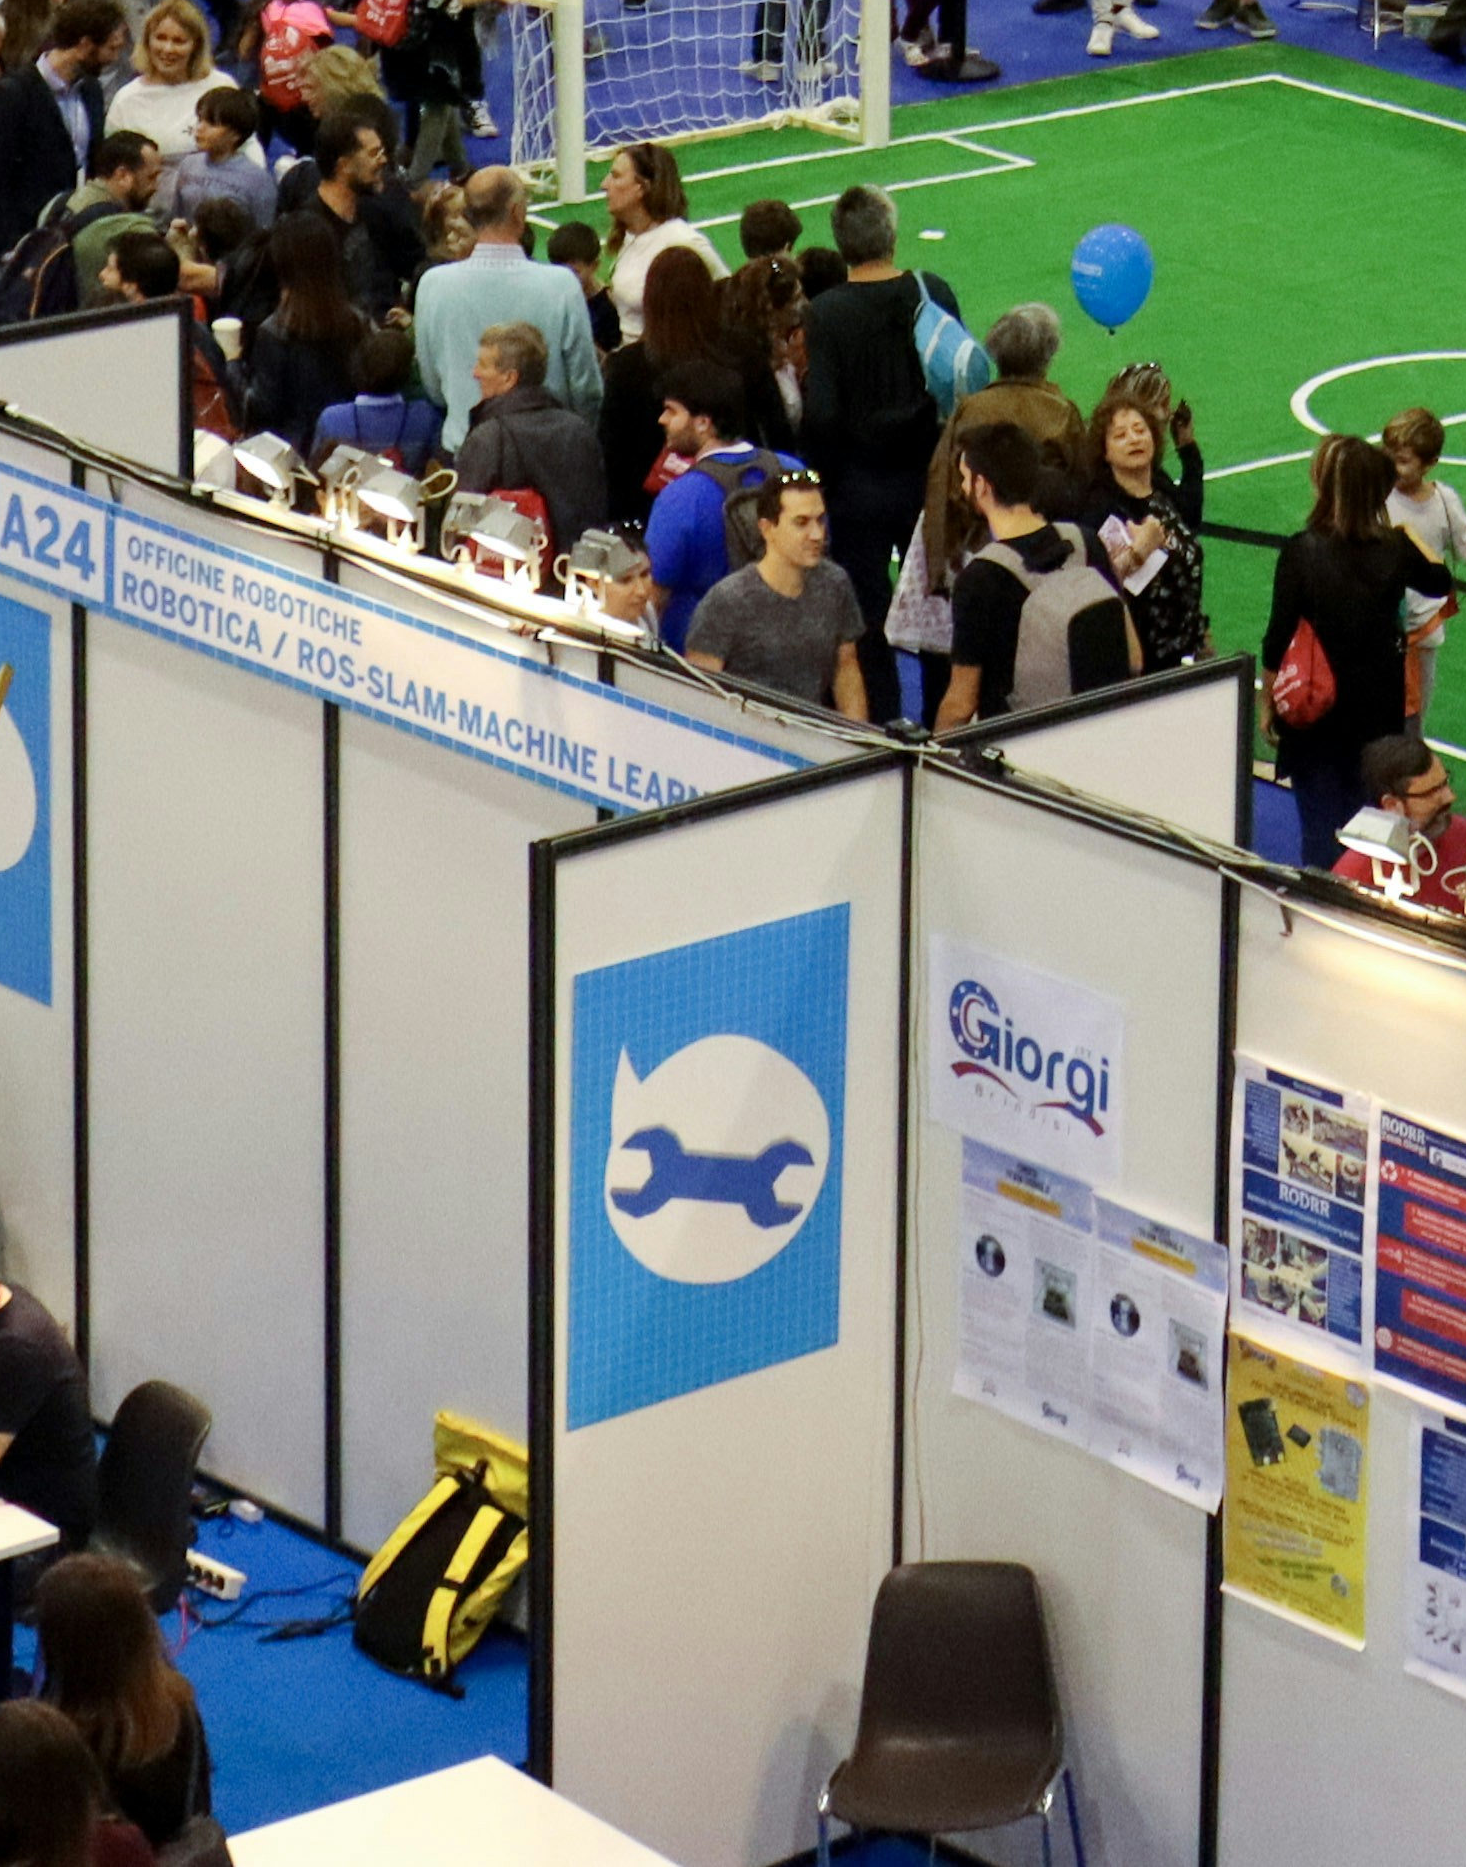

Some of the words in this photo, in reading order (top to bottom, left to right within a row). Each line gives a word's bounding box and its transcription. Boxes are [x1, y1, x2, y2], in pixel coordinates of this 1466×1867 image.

[0, 492, 96, 582] A24
[127, 534, 226, 596] OFFICINE
[232, 573, 363, 647] ROBOTICHE
[121, 571, 263, 656] ROBOTICA
[272, 630, 288, 660] /
[297, 641, 599, 784] ROS-SLAM-MACHINE
[949, 979, 1110, 1118] Giorgi
[1381, 1113, 1426, 1147] RODRR
[1278, 1183, 1331, 1219] RODRR
